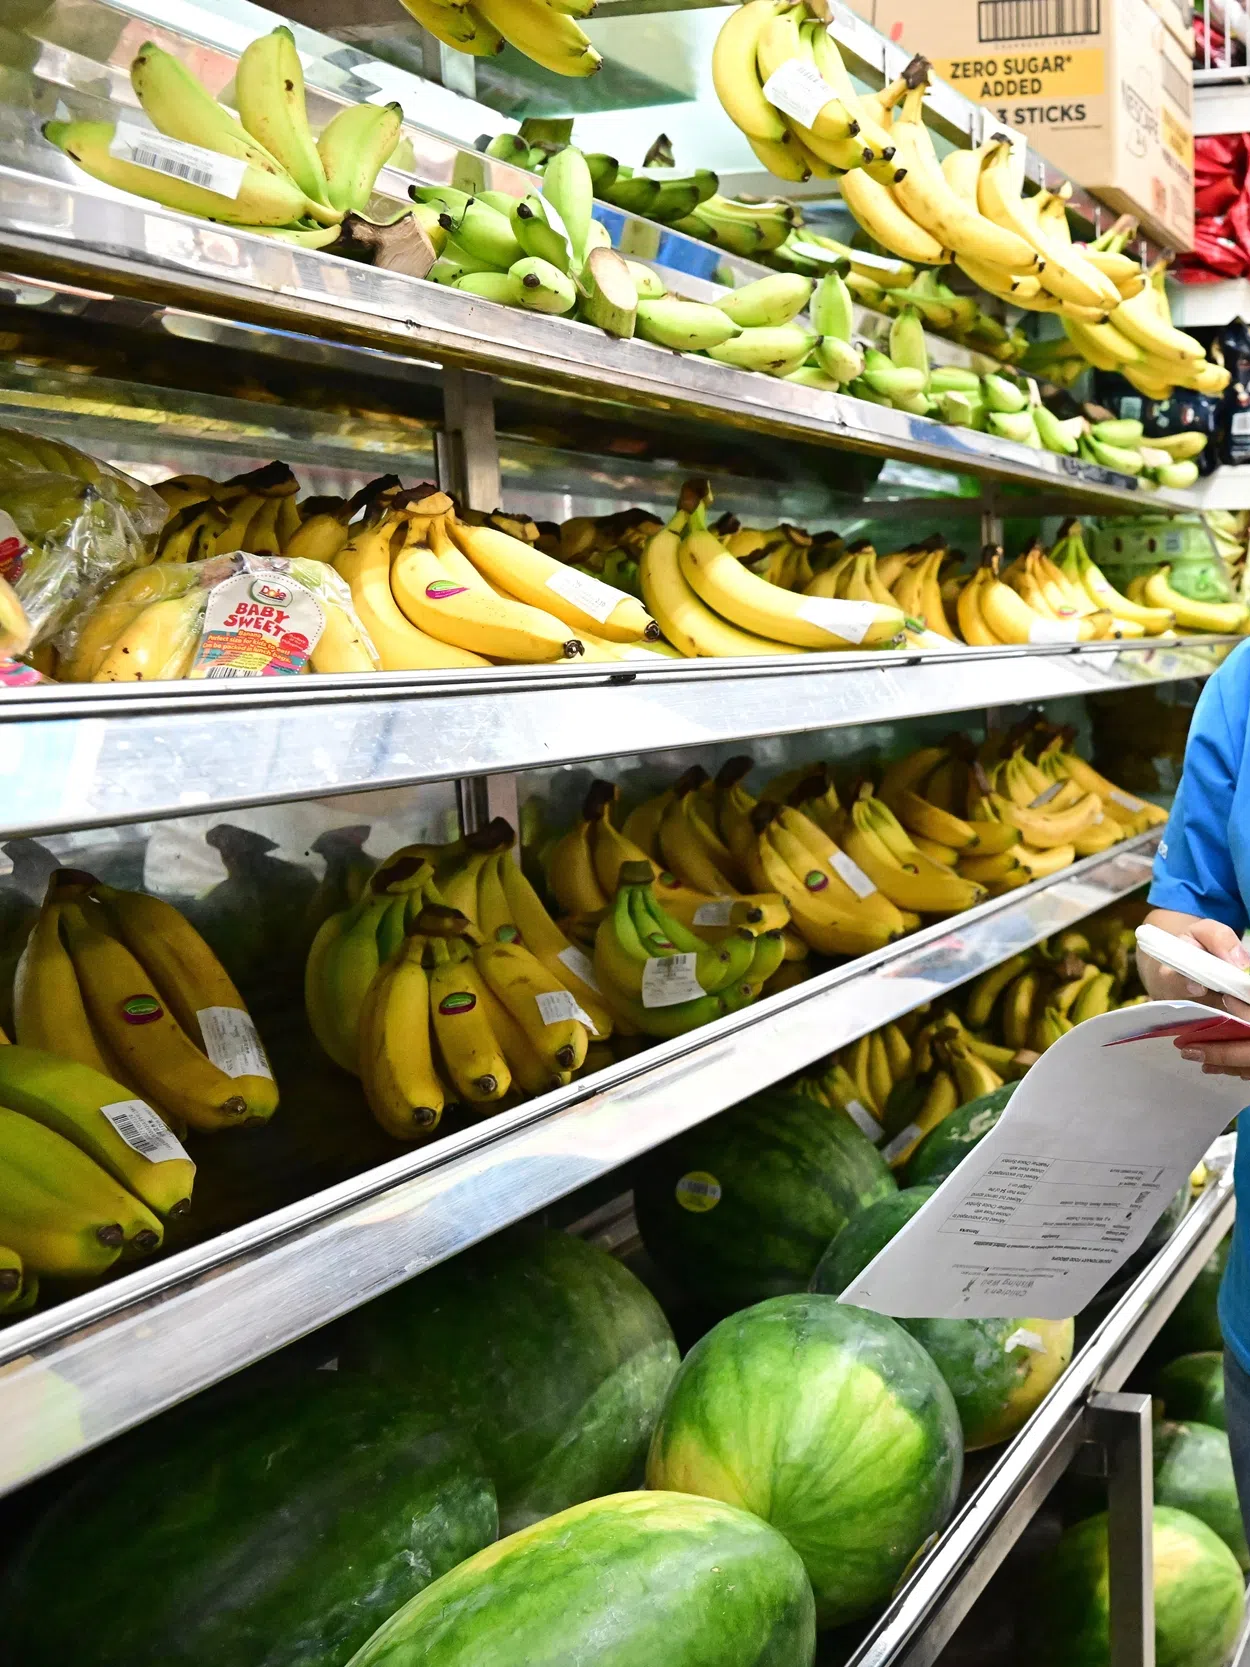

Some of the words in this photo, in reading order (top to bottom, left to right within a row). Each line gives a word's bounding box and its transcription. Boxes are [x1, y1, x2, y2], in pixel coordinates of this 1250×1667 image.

[950, 62, 997, 79] ZERO
[980, 78, 1042, 98] ADDED
[1014, 105, 1086, 126] STICKS
[260, 585, 287, 600] Dole
[235, 602, 291, 624] BABY
[223, 614, 287, 637] SWEET
[238, 630, 262, 639] Banana
[208, 634, 229, 643] Perfect
[253, 638, 267, 648] kids
[276, 647, 291, 655] eat!
[223, 644, 246, 652] packed
[253, 647, 271, 657] lunch
[1002, 1279, 1034, 1288] Wishing
[984, 1288, 1027, 1297] Children's
